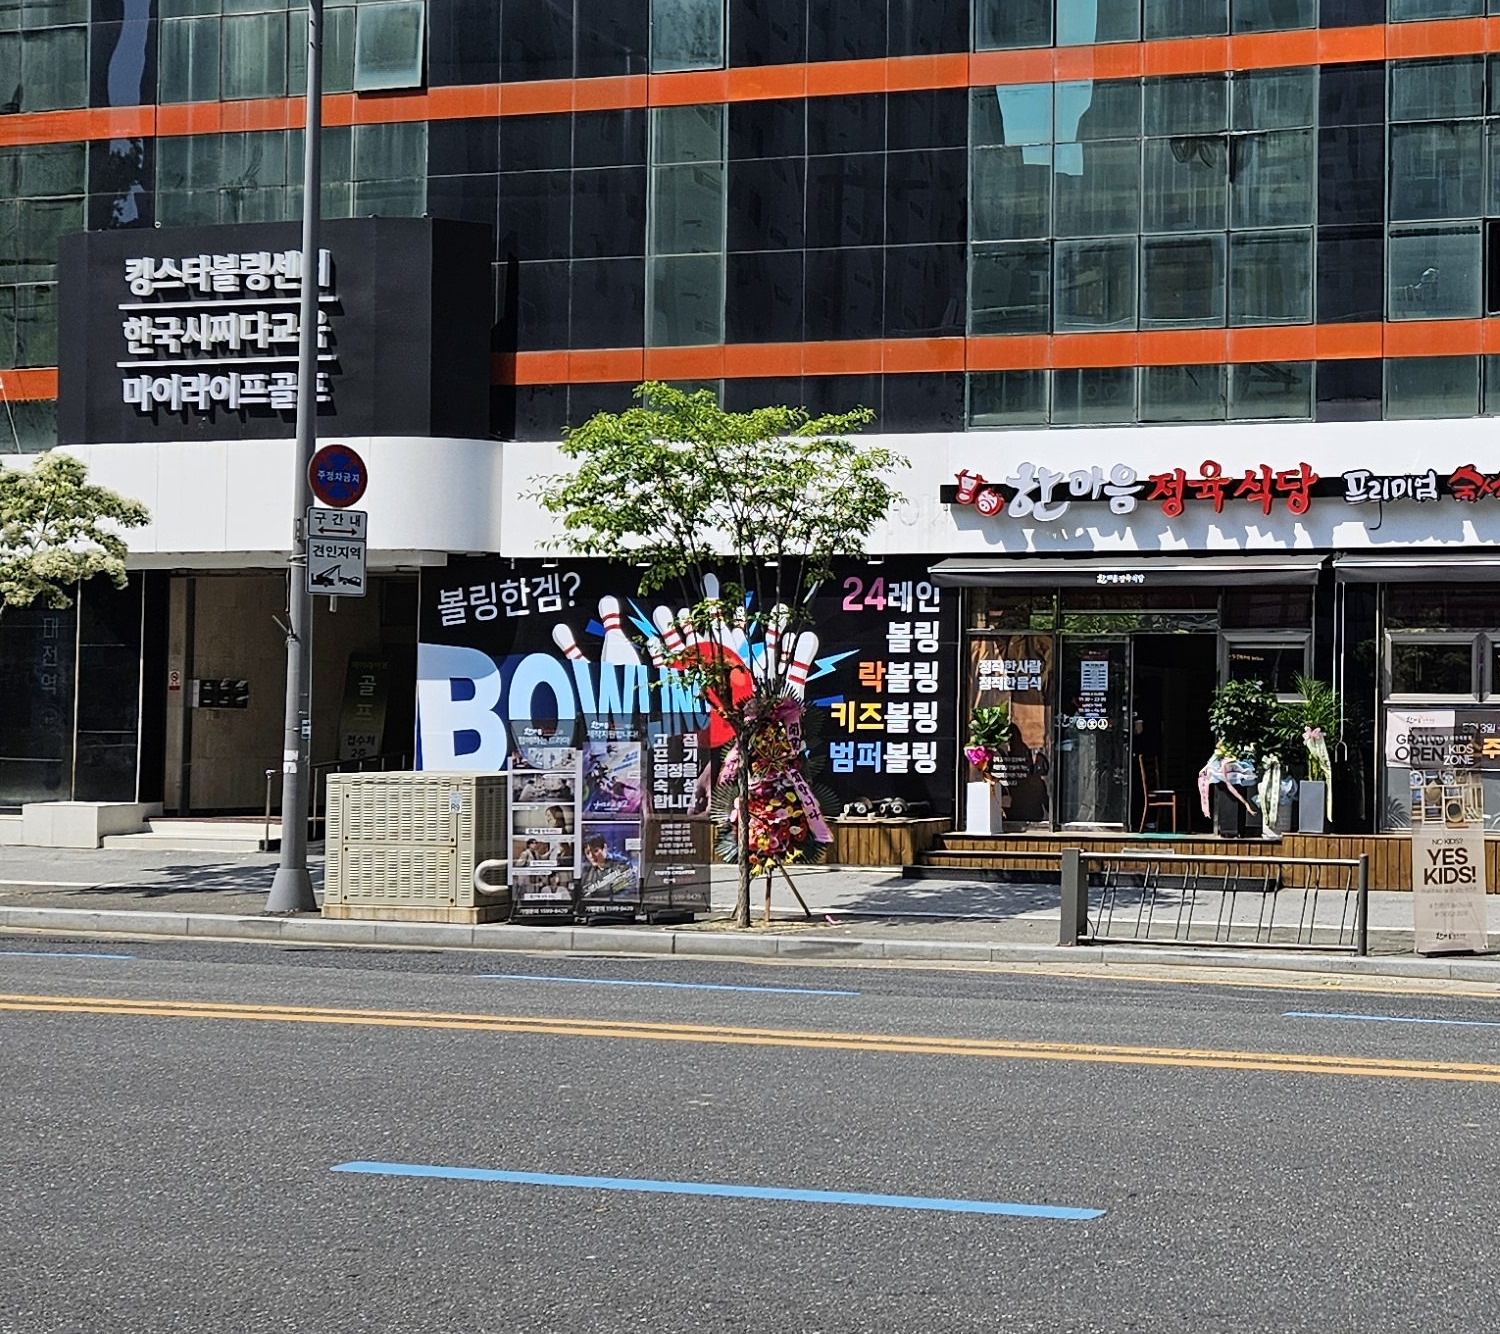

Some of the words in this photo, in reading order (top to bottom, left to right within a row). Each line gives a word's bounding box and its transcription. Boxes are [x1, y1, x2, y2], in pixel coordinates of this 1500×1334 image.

[317, 470, 360, 484] 주정차금지
[1343, 468, 1439, 503] 프리미엄
[312, 545, 362, 560] 견인지역
[842, 577, 941, 614] 24레인
[885, 620, 941, 654] 볼링
[858, 660, 940, 694] 락볼링
[830, 700, 939, 734] 키즈볼링
[1480, 722, 1496, 735] 3일
[346, 733, 376, 748] 접수처
[1395, 733, 1446, 746] GRAND
[829, 740, 938, 774] 범퍼볼링
[1394, 746, 1445, 762] OPEN
[1448, 743, 1475, 755] KIDS
[1443, 754, 1475, 766] ZONE
[653, 794, 698, 810] 합니다
[1444, 837, 1464, 845] KIDS?
[1426, 847, 1469, 866] YES
[1423, 866, 1477, 886] KIDS!
